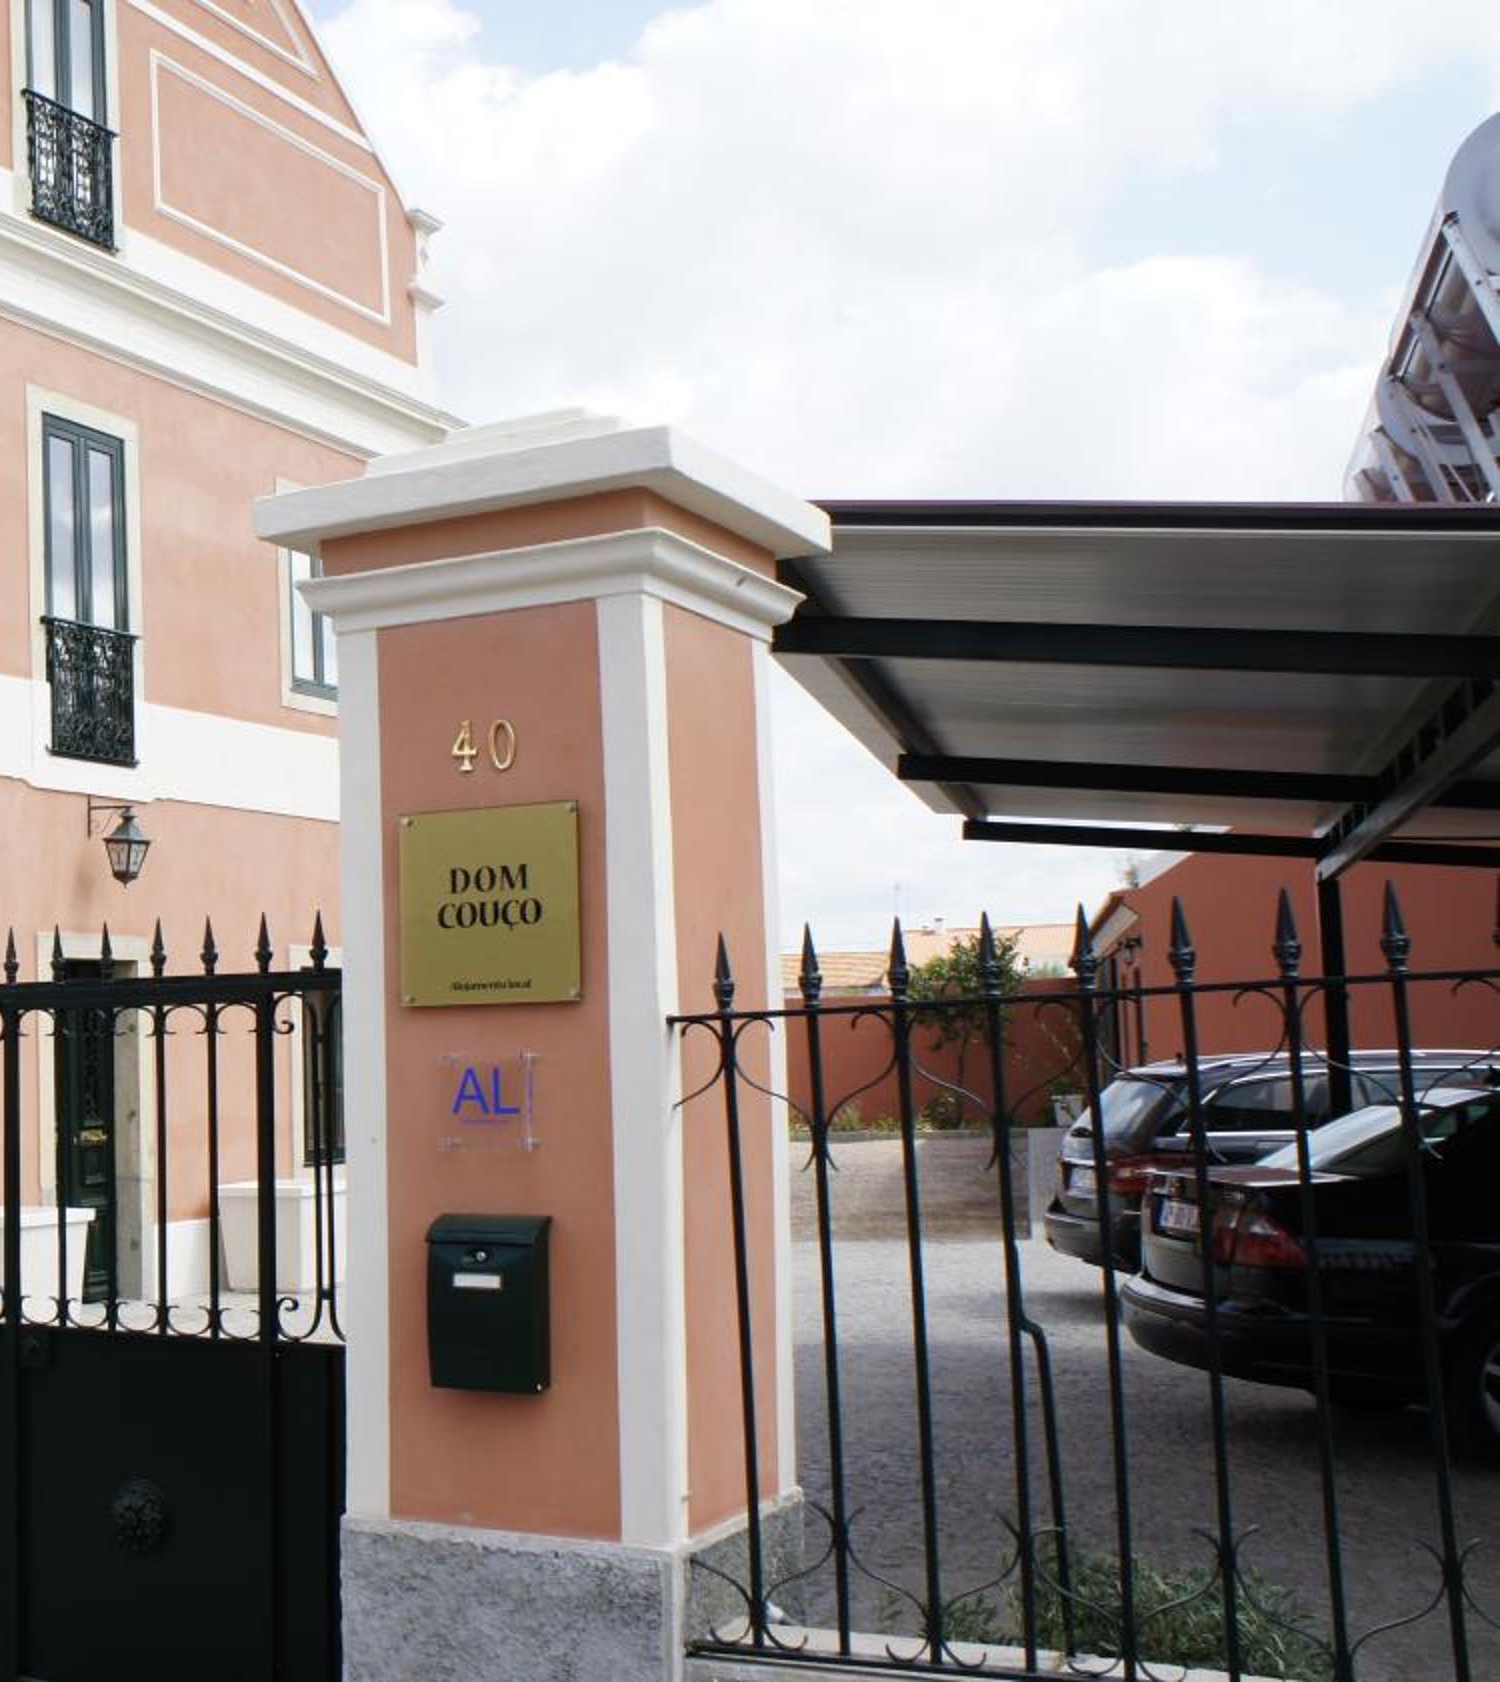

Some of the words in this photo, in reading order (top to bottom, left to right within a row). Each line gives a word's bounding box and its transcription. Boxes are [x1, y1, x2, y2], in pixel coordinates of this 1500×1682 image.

[451, 719, 516, 772] 40
[450, 863, 528, 894] DOM
[437, 897, 542, 931] COUÇO
[452, 1067, 520, 1115] AL
